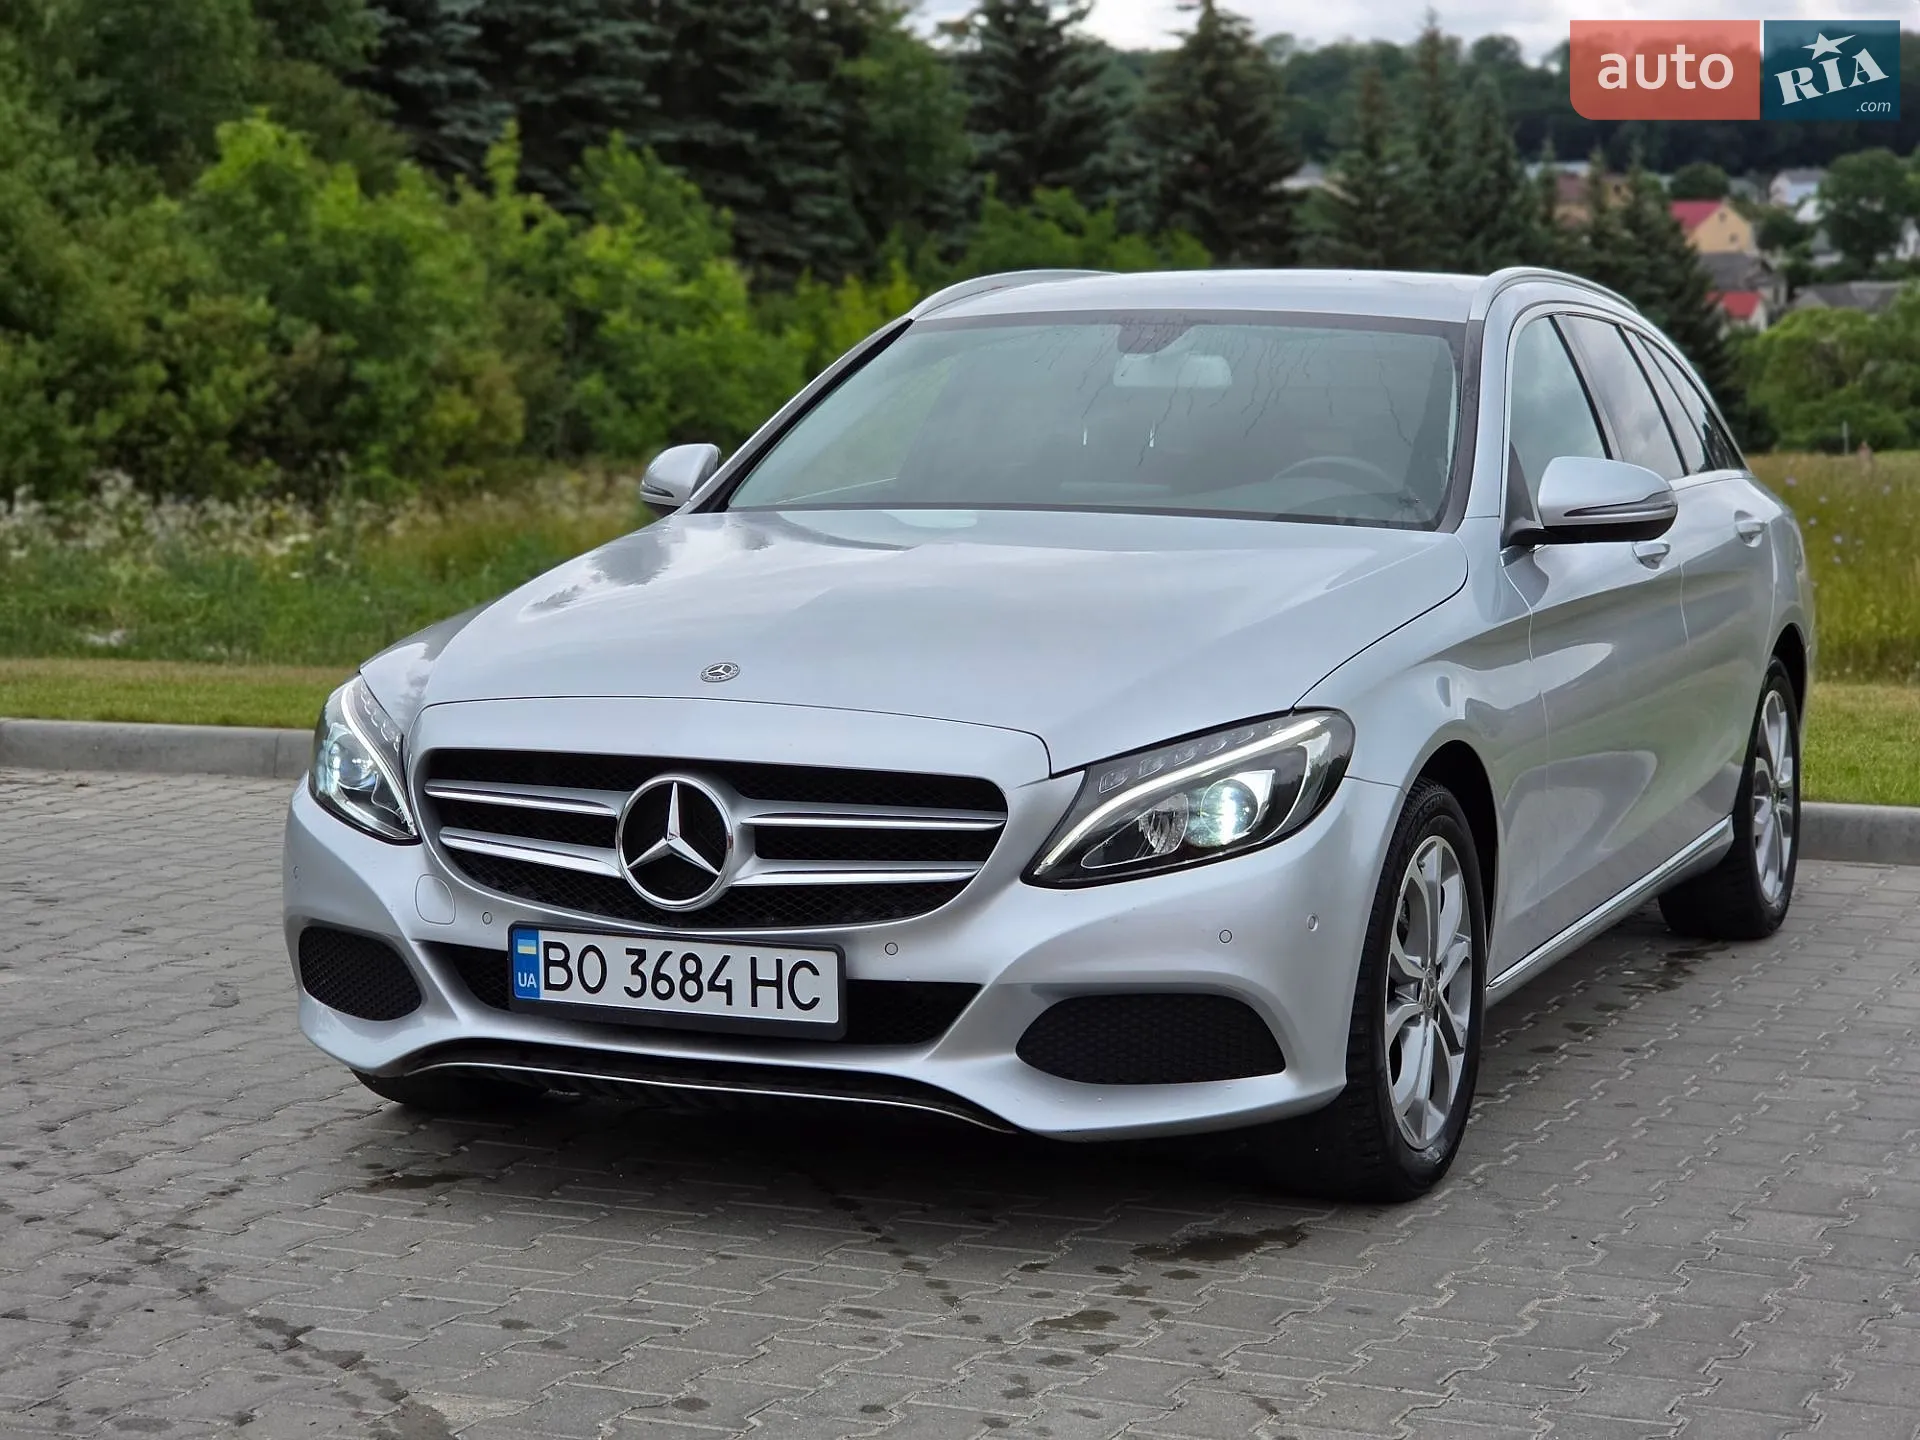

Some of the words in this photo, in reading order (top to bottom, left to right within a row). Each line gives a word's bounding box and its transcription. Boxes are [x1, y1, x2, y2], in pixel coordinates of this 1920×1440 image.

[517, 972, 537, 989] UA
[543, 941, 607, 994] BO
[623, 948, 733, 1006] 3684
[750, 956, 820, 1011] HC
